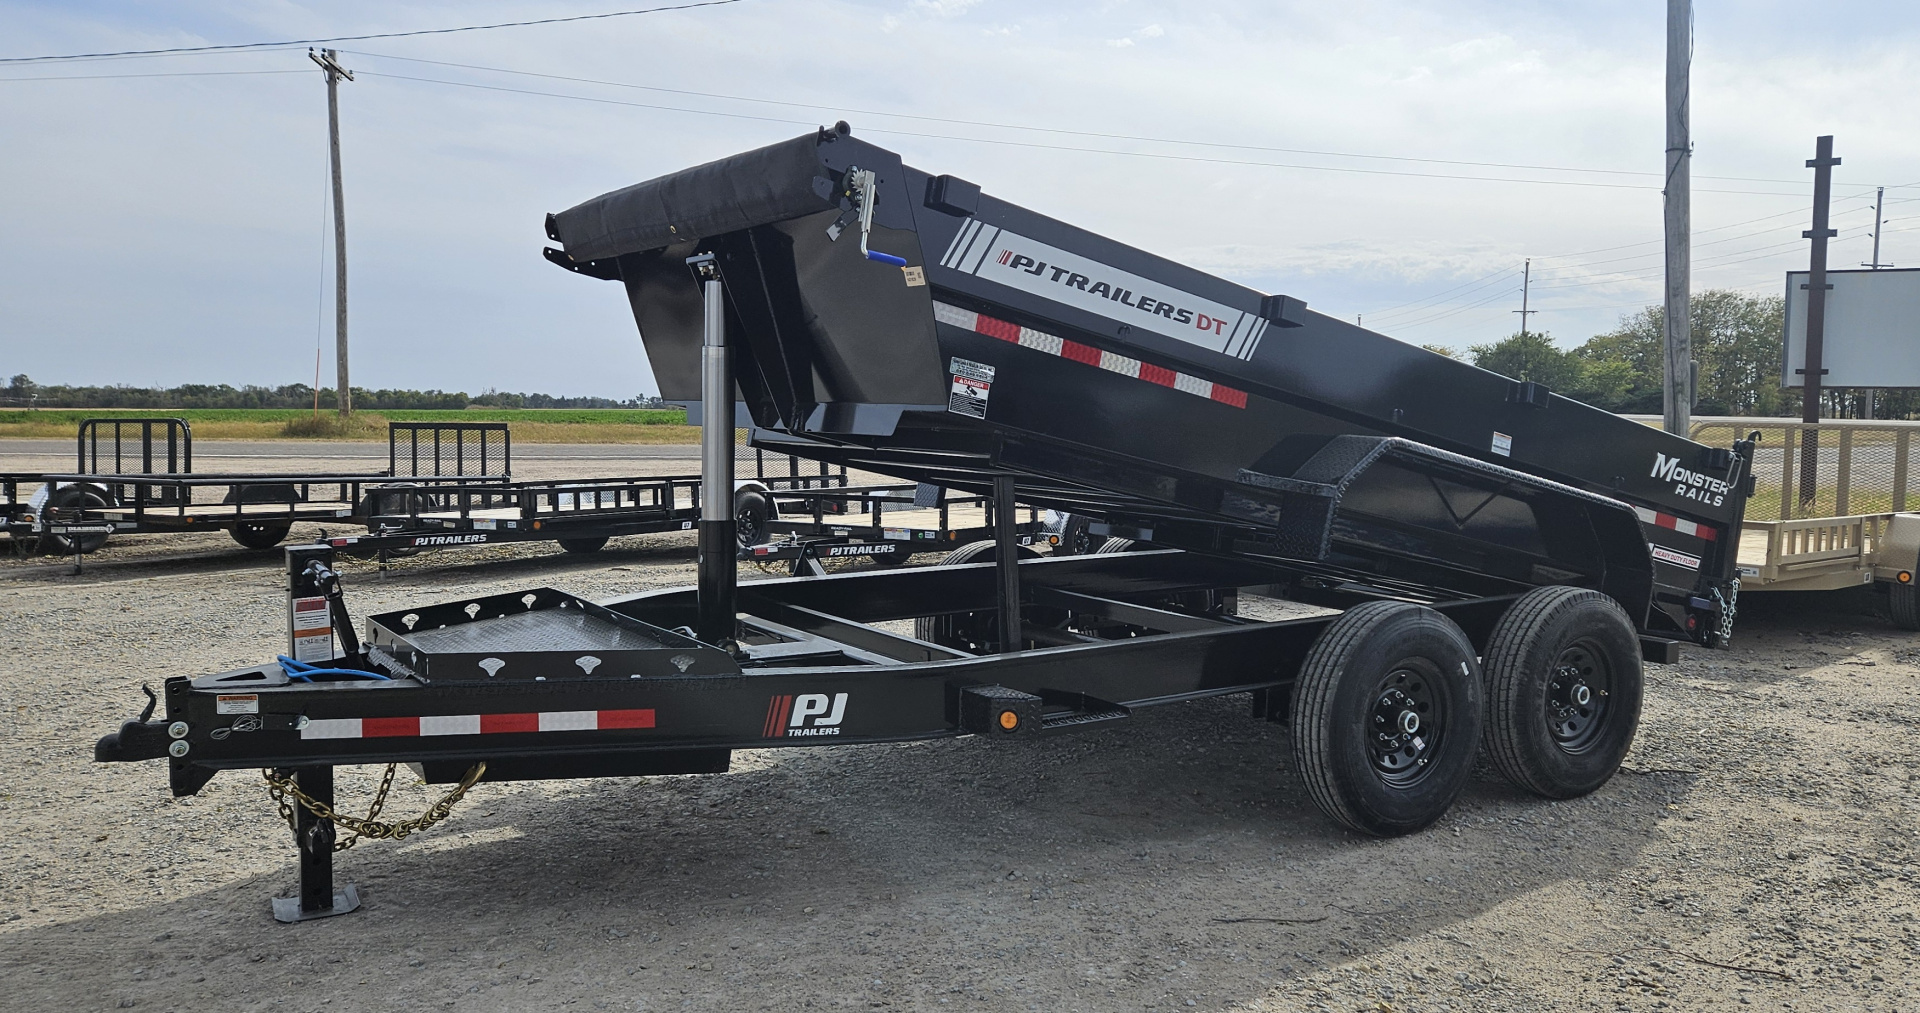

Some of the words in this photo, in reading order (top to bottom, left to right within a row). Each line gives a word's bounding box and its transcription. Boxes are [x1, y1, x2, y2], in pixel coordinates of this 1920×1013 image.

[1009, 254, 1047, 276] PJ
[1050, 265, 1194, 325] TRAILERS
[1196, 312, 1228, 336] DT
[963, 379, 985, 389] DANGER
[1674, 483, 1724, 507] RAILS
[415, 537, 429, 546] PJ
[429, 534, 487, 545] TRAILERS
[829, 547, 843, 556] PJ
[843, 544, 895, 555] TRAILERS
[1655, 550, 1670, 559] HEAVY
[1670, 554, 1682, 562] DUTY
[1683, 557, 1698, 566] FLOOR
[789, 692, 849, 727] PJ
[788, 727, 840, 737] TRAILERS
